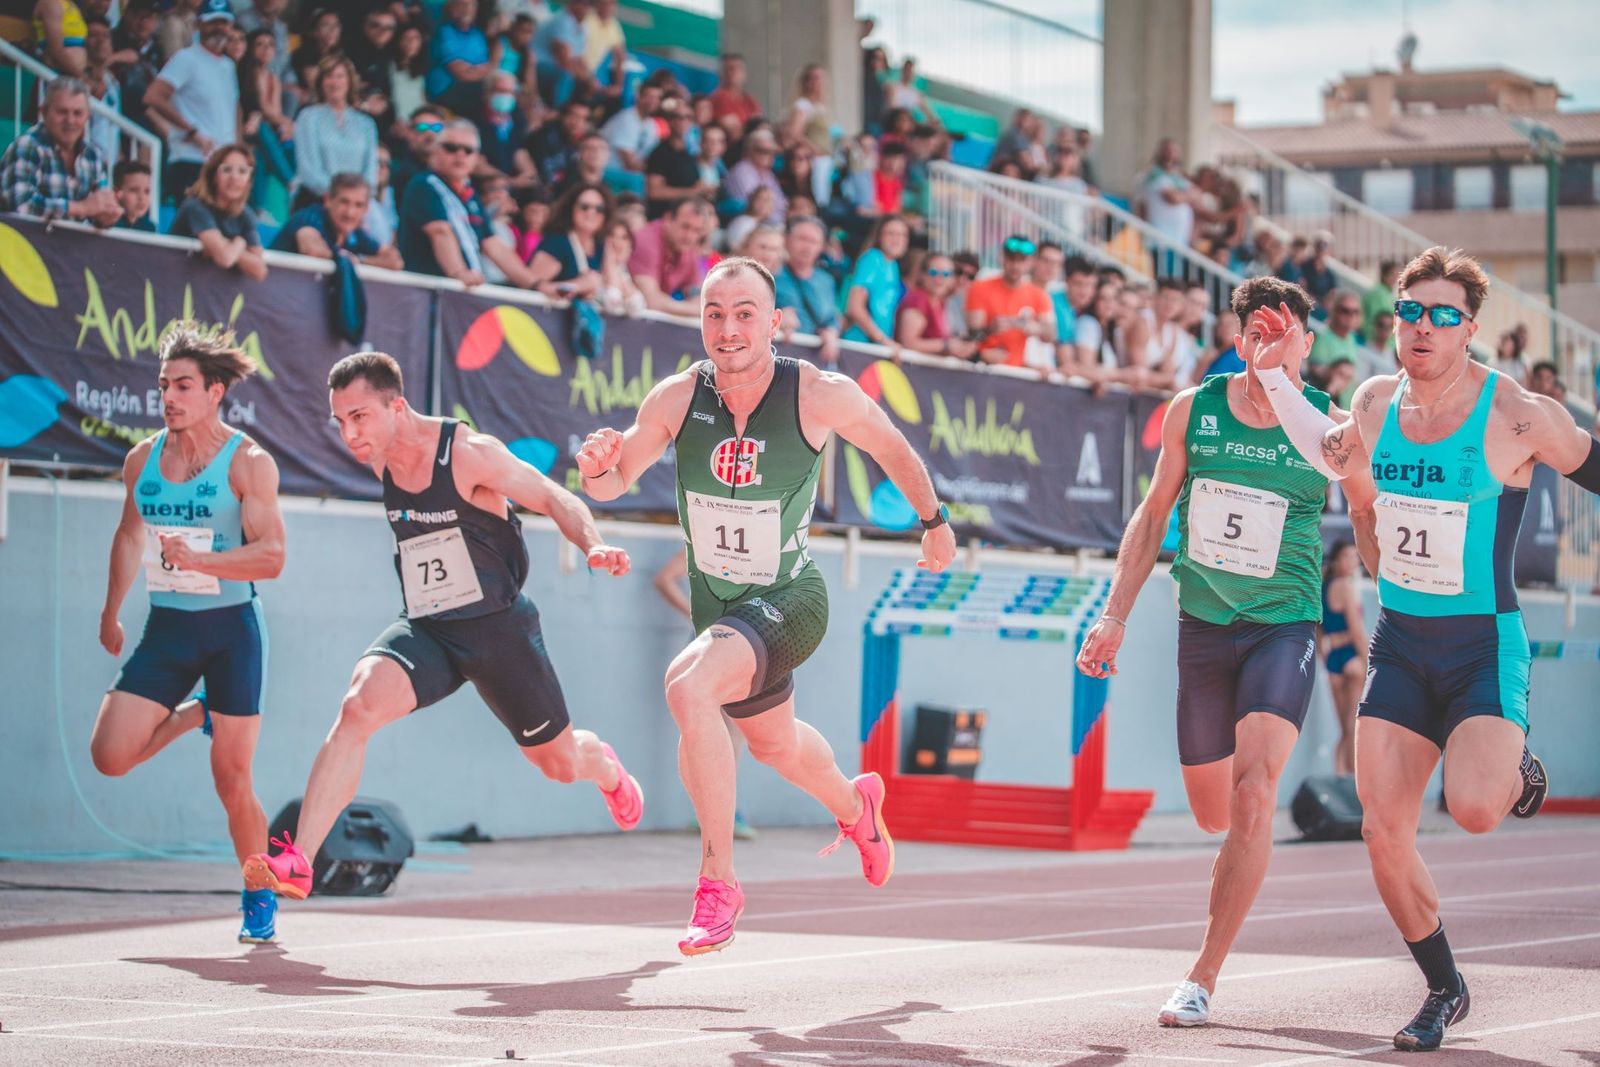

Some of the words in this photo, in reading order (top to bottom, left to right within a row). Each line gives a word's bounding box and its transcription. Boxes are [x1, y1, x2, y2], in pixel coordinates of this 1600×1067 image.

[76, 380, 143, 419] Región
[1371, 458, 1446, 489] nerja
[141, 500, 213, 521] nerja
[715, 524, 749, 554] 11
[1223, 512, 1243, 540] 5
[1396, 526, 1431, 558] 21
[417, 558, 448, 585] 73
